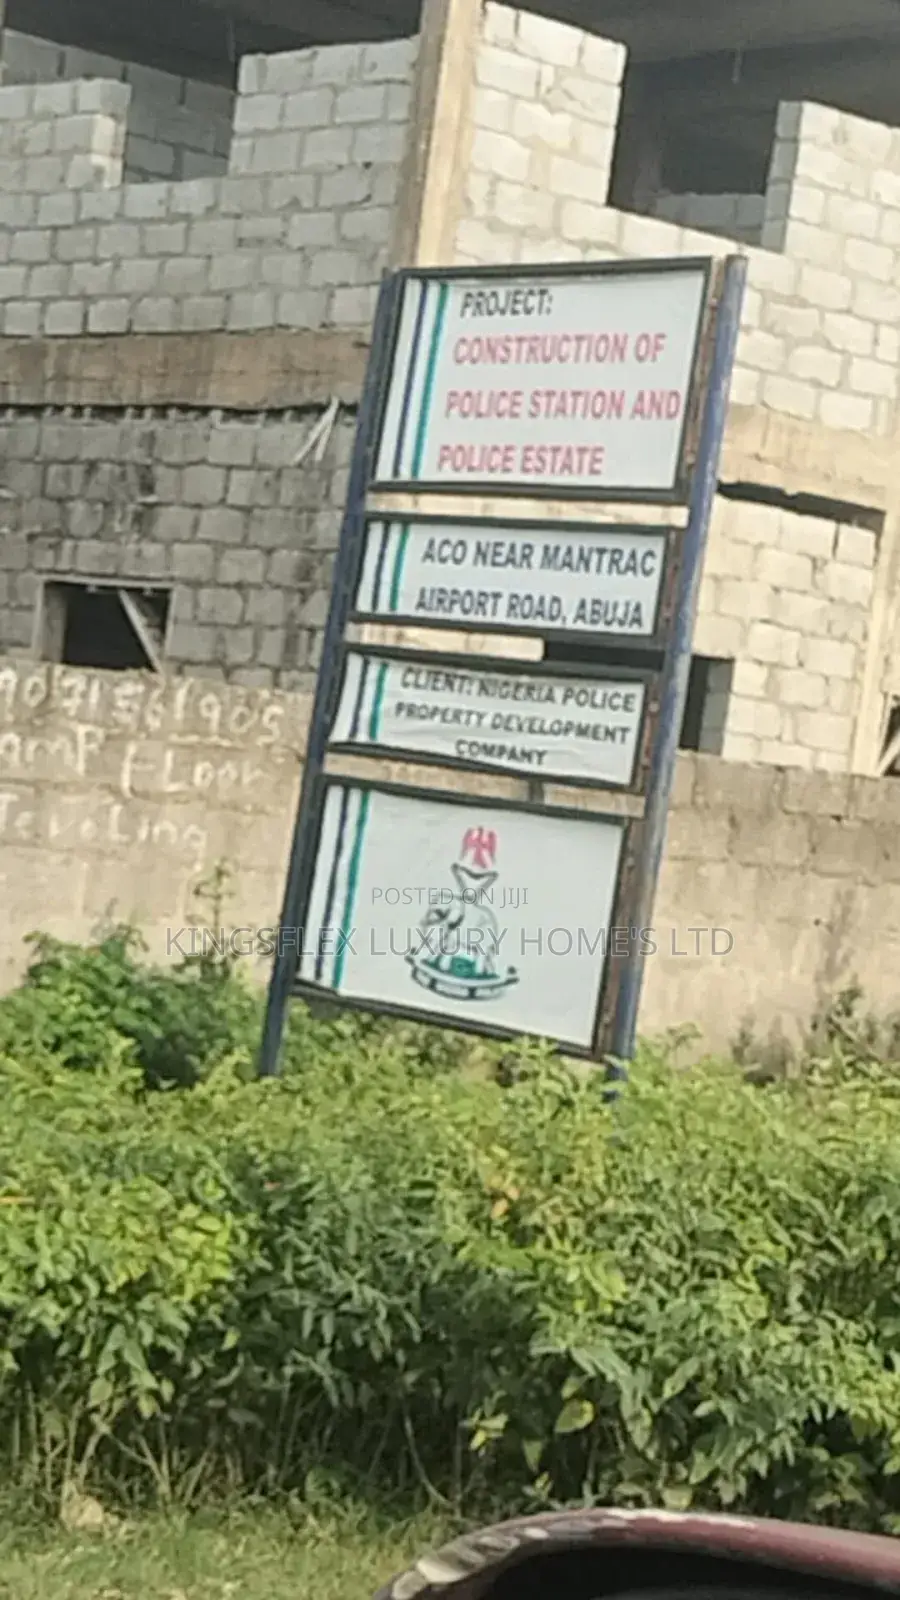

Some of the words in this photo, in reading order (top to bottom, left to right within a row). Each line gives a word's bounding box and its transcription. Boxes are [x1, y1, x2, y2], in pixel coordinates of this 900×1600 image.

[460, 288, 552, 318] PROJECT:
[453, 333, 628, 364] CONSTRUCTION
[635, 333, 667, 362] OF
[445, 390, 524, 420] POLICE
[528, 390, 626, 420] STATION
[629, 390, 681, 420] AND
[437, 445, 516, 473] POLICE
[520, 446, 604, 475] ESTATE
[421, 538, 467, 564] ACO
[472, 541, 533, 570] NEAR
[539, 545, 656, 577] MANTRAC
[415, 586, 502, 617] AIRPORT
[506, 594, 568, 625] ROAD,
[572, 599, 643, 627] ABUJA
[400, 667, 473, 697] CLIENT:
[477, 677, 555, 705] NIGERIA
[561, 686, 636, 713] POLICE
[395, 702, 487, 729] PROPERTY
[490, 713, 632, 744] DEVELOPMENT
[454, 739, 548, 765] COMPANY
